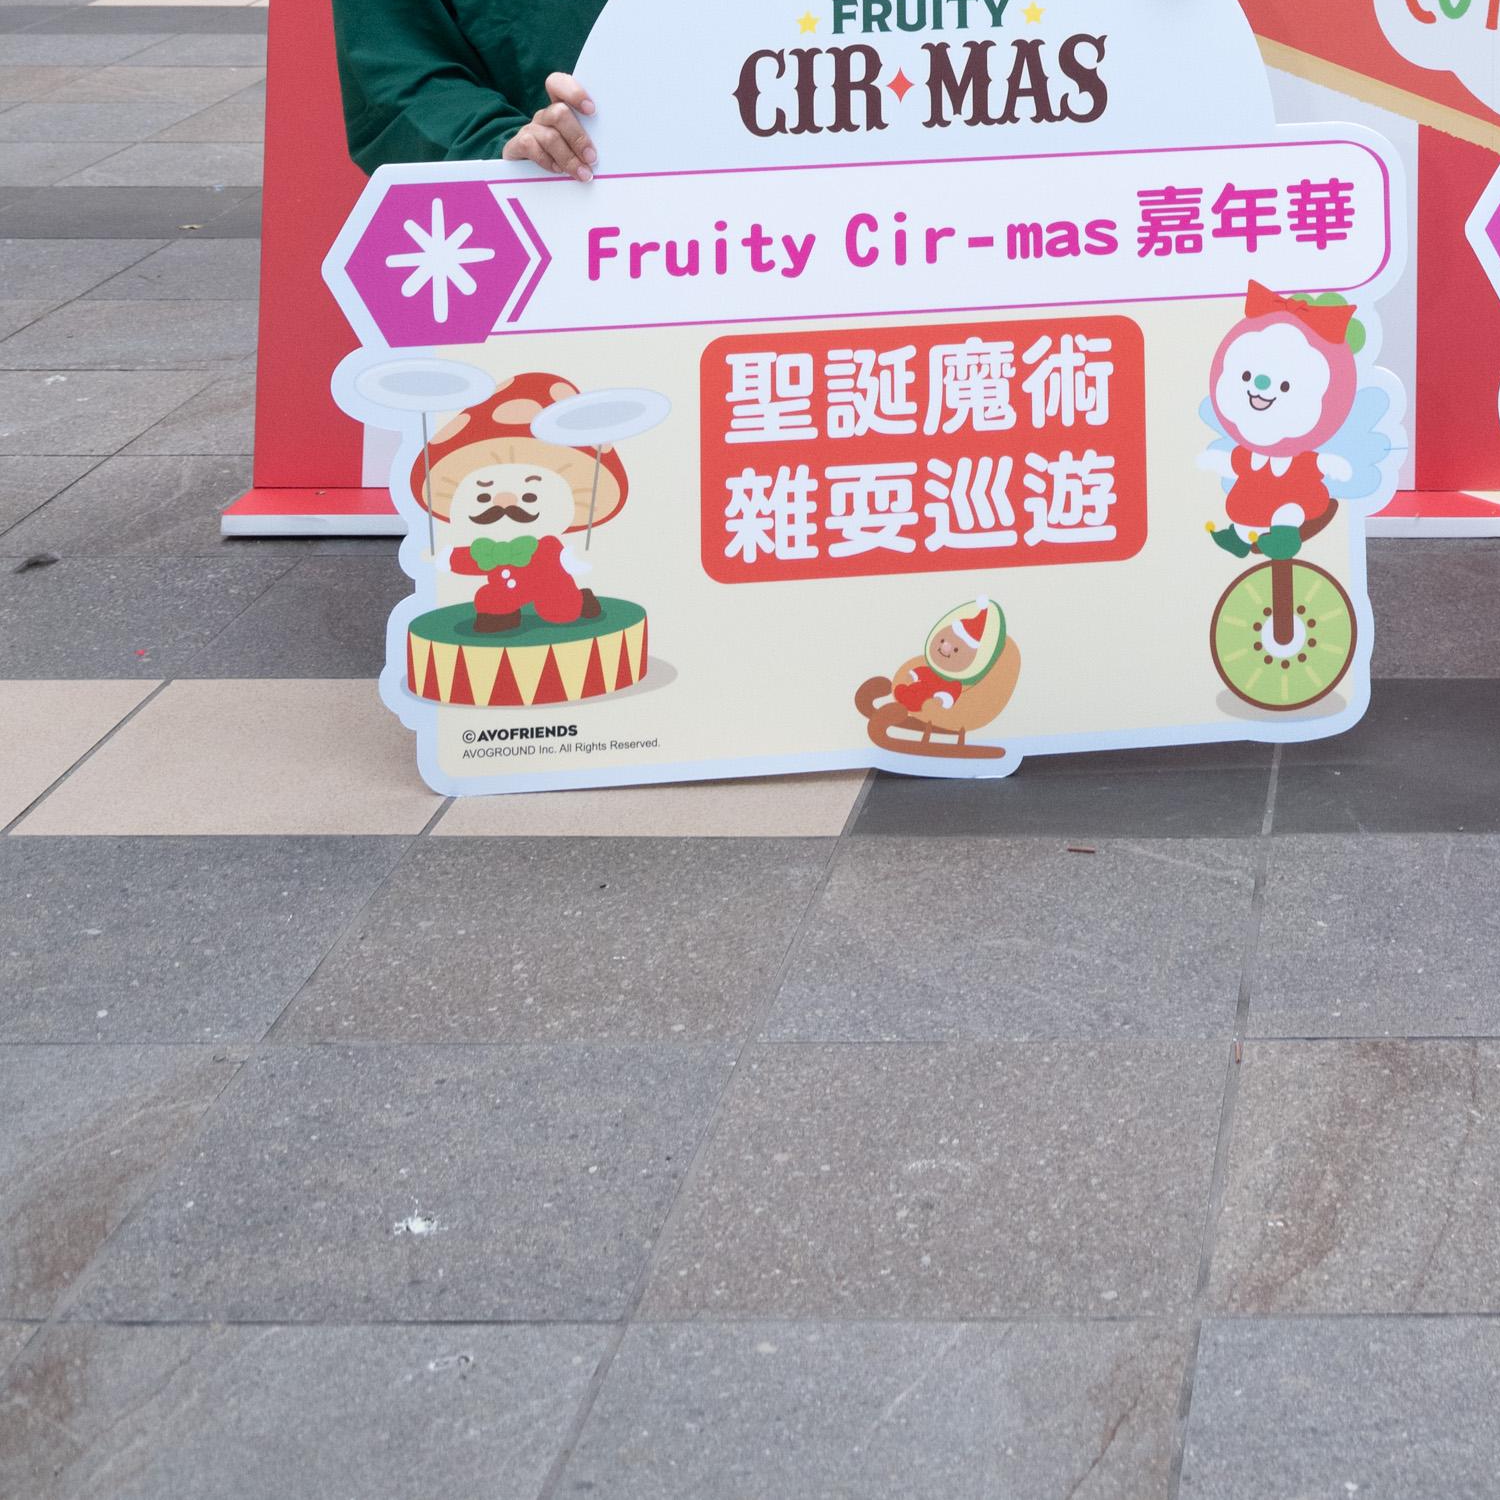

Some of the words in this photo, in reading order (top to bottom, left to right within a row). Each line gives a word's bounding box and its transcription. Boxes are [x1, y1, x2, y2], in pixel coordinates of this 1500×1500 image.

[587, 221, 816, 281] Fruity
[844, 211, 1118, 267] Cir-mas
[1135, 178, 1355, 259] 嘉年華
[723, 334, 1114, 445] 聖誕魔術
[723, 449, 1118, 564] 雜耍巡遊
[462, 745, 536, 760] AVOGROUND
[538, 744, 558, 755] Inc.
[559, 742, 573, 753] All
[575, 740, 607, 754] Rights
[610, 738, 661, 750] Reserved.
